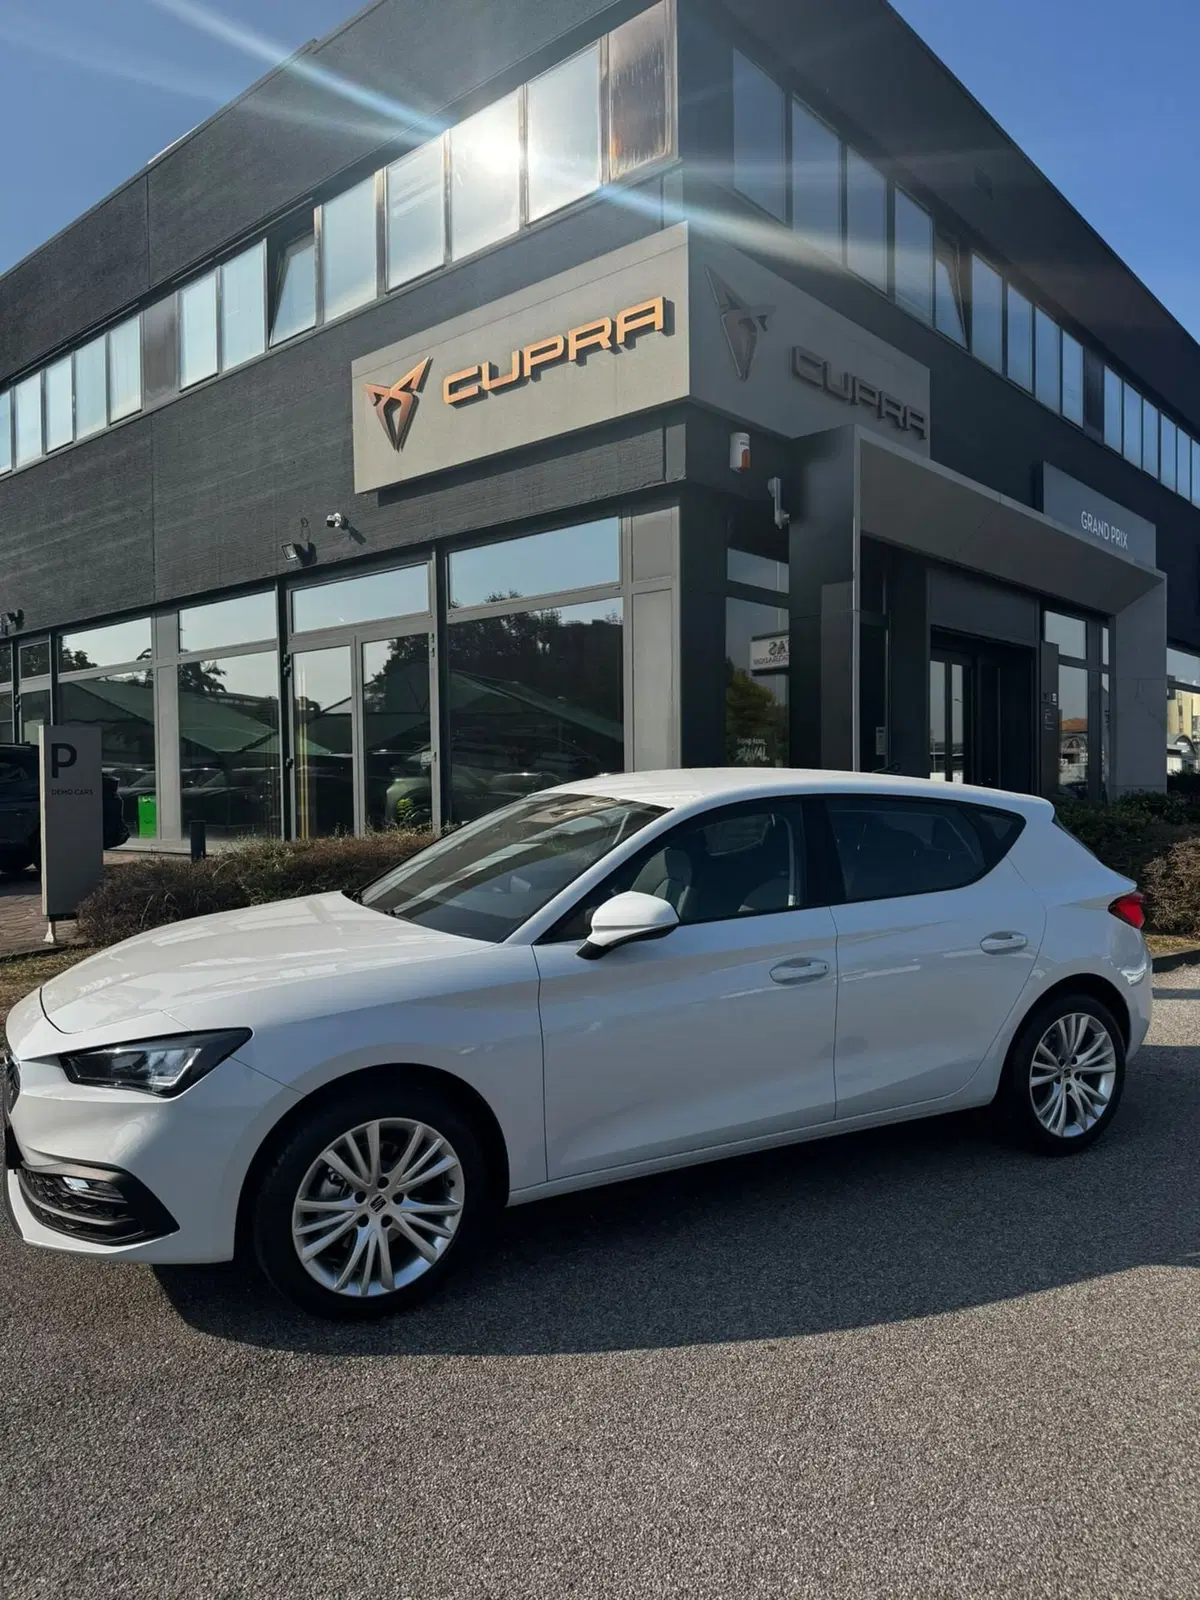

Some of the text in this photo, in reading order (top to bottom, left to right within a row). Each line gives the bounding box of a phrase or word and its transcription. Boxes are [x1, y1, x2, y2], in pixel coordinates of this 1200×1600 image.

[442, 296, 664, 404] CUPRA
[791, 345, 928, 440] CUPRA
[1081, 511, 1128, 551] GRAND PRIX
[51, 743, 77, 779] P
[51, 788, 94, 796] DEMO CARS
